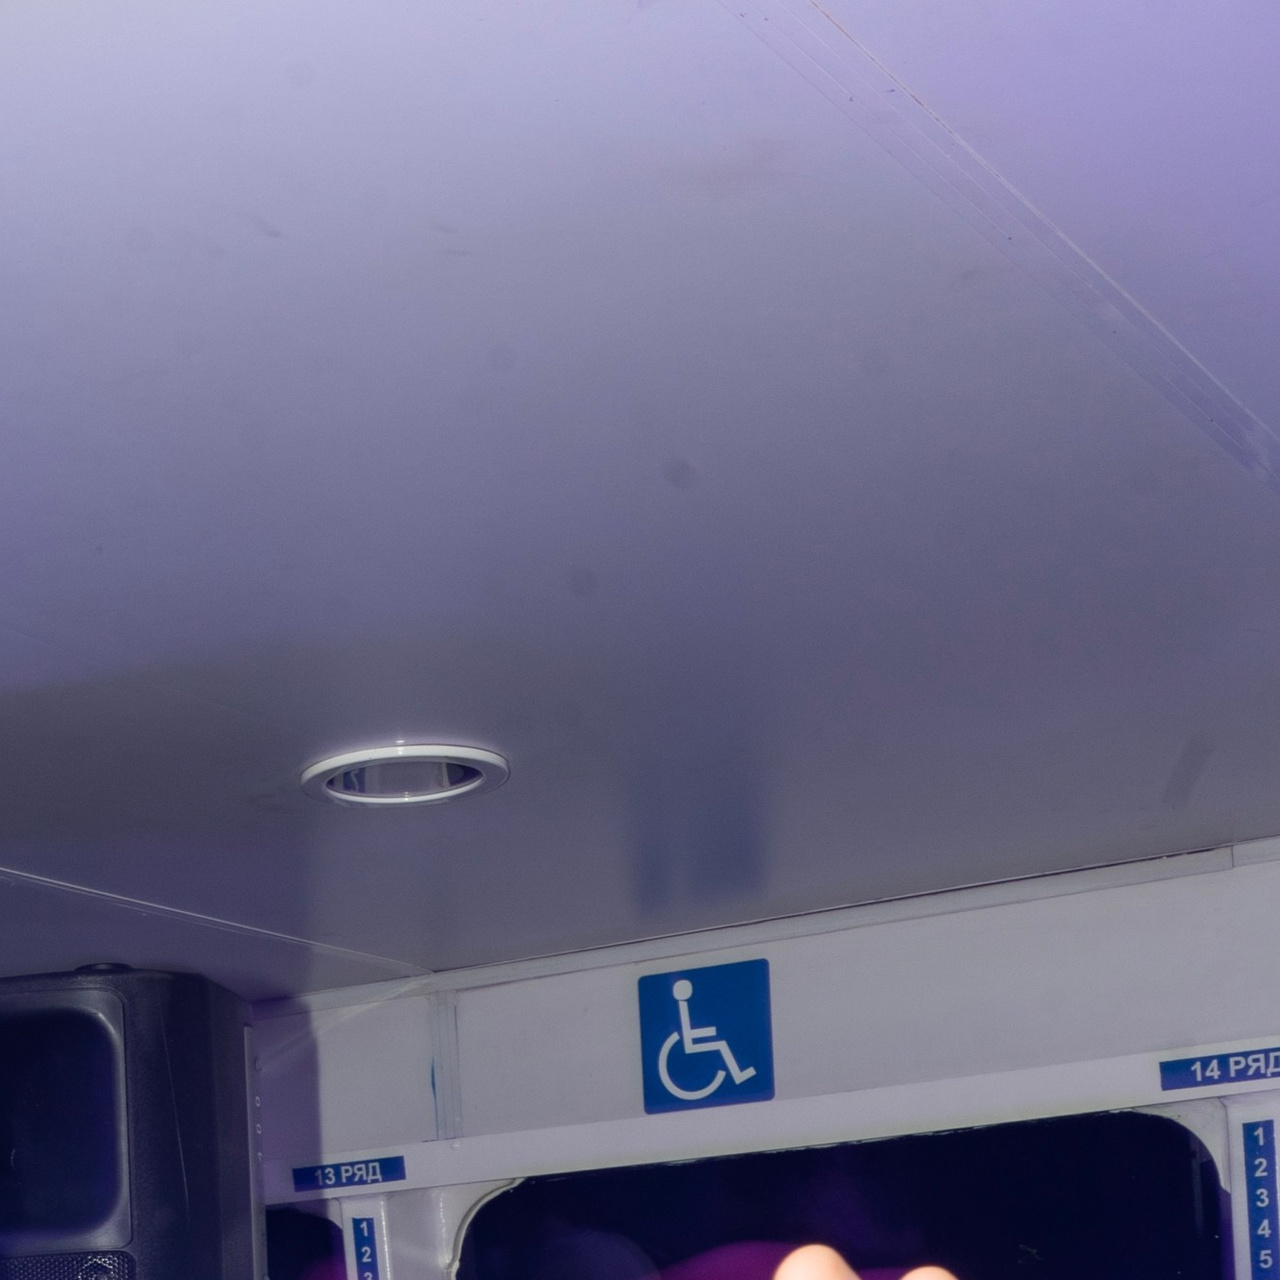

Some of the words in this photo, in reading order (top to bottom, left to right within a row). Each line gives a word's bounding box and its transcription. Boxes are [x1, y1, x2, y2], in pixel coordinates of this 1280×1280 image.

[1190, 1059, 1221, 1082] 14
[1228, 1051, 1280, 1078] РЯД
[1253, 1126, 1265, 1147] 1
[314, 1167, 336, 1186] 13
[341, 1161, 383, 1184] РЯД
[1254, 1157, 1269, 1177] 2
[1255, 1188, 1270, 1208] 3
[360, 1220, 368, 1237] 1
[1257, 1219, 1272, 1239] 4
[361, 1246, 372, 1263] 2
[1259, 1249, 1273, 1269] 5
